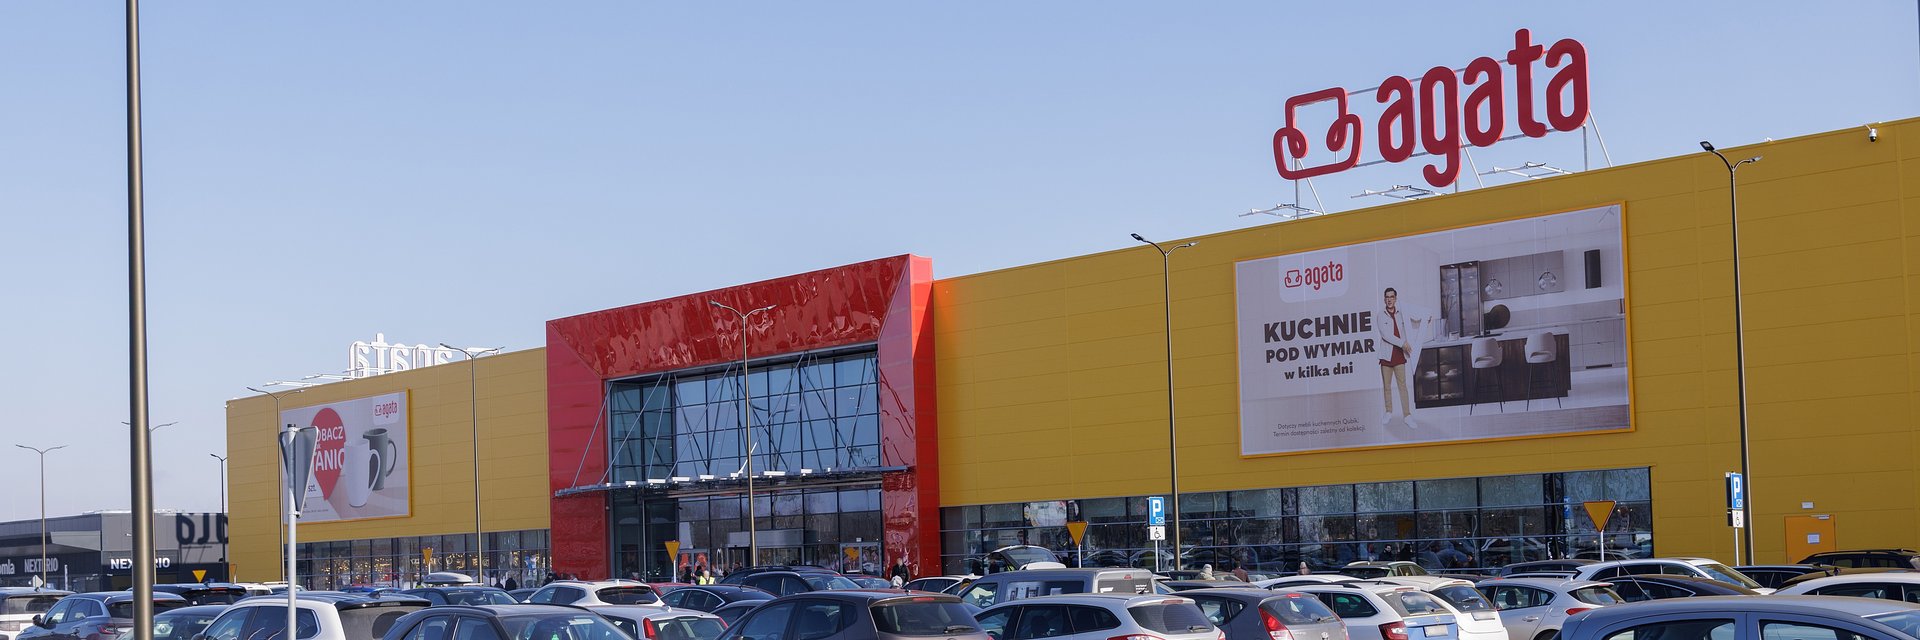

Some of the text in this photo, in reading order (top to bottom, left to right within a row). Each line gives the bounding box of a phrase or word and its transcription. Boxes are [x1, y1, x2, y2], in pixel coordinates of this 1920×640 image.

[1376, 28, 1589, 187] agata
[1304, 260, 1343, 291] agata
[1264, 311, 1372, 344] KUCHNIE
[1266, 338, 1376, 364] POD WYMIAR
[1284, 361, 1354, 380] w kilka dni
[382, 401, 397, 419] agata
[316, 426, 344, 442] OBACZ
[313, 448, 345, 472] ANIO
[1733, 477, 1740, 499] P
[1153, 499, 1162, 518] P
[24, 557, 59, 573] NEXTRIO
[110, 557, 171, 570] NEXIO
